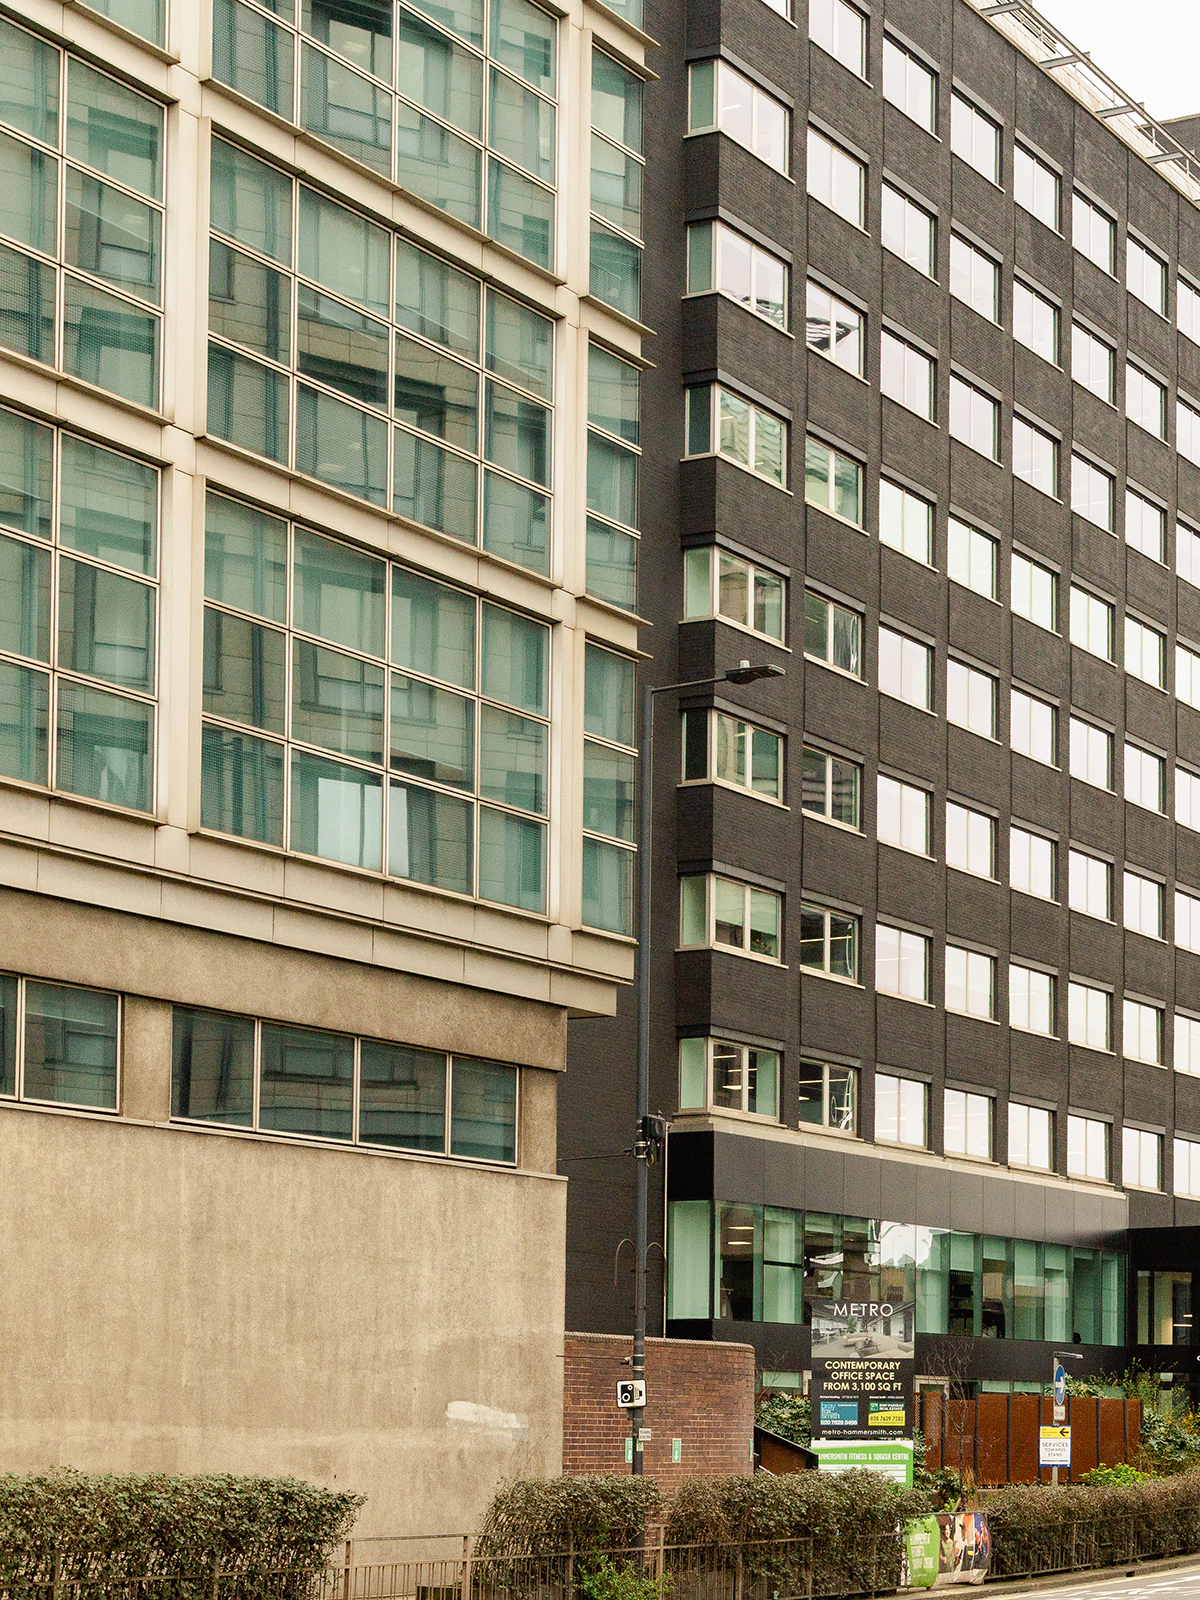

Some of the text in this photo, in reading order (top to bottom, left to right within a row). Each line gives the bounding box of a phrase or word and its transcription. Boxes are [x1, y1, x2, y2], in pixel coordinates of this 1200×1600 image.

[833, 1303, 894, 1317] METRO
[824, 1361, 901, 1370] CONTEMPORARY
[831, 1371, 895, 1380] OFFICE SPACE
[823, 1382, 902, 1392] FROM 3,100 SQ FT
[873, 1453, 892, 1461] SQUASH
